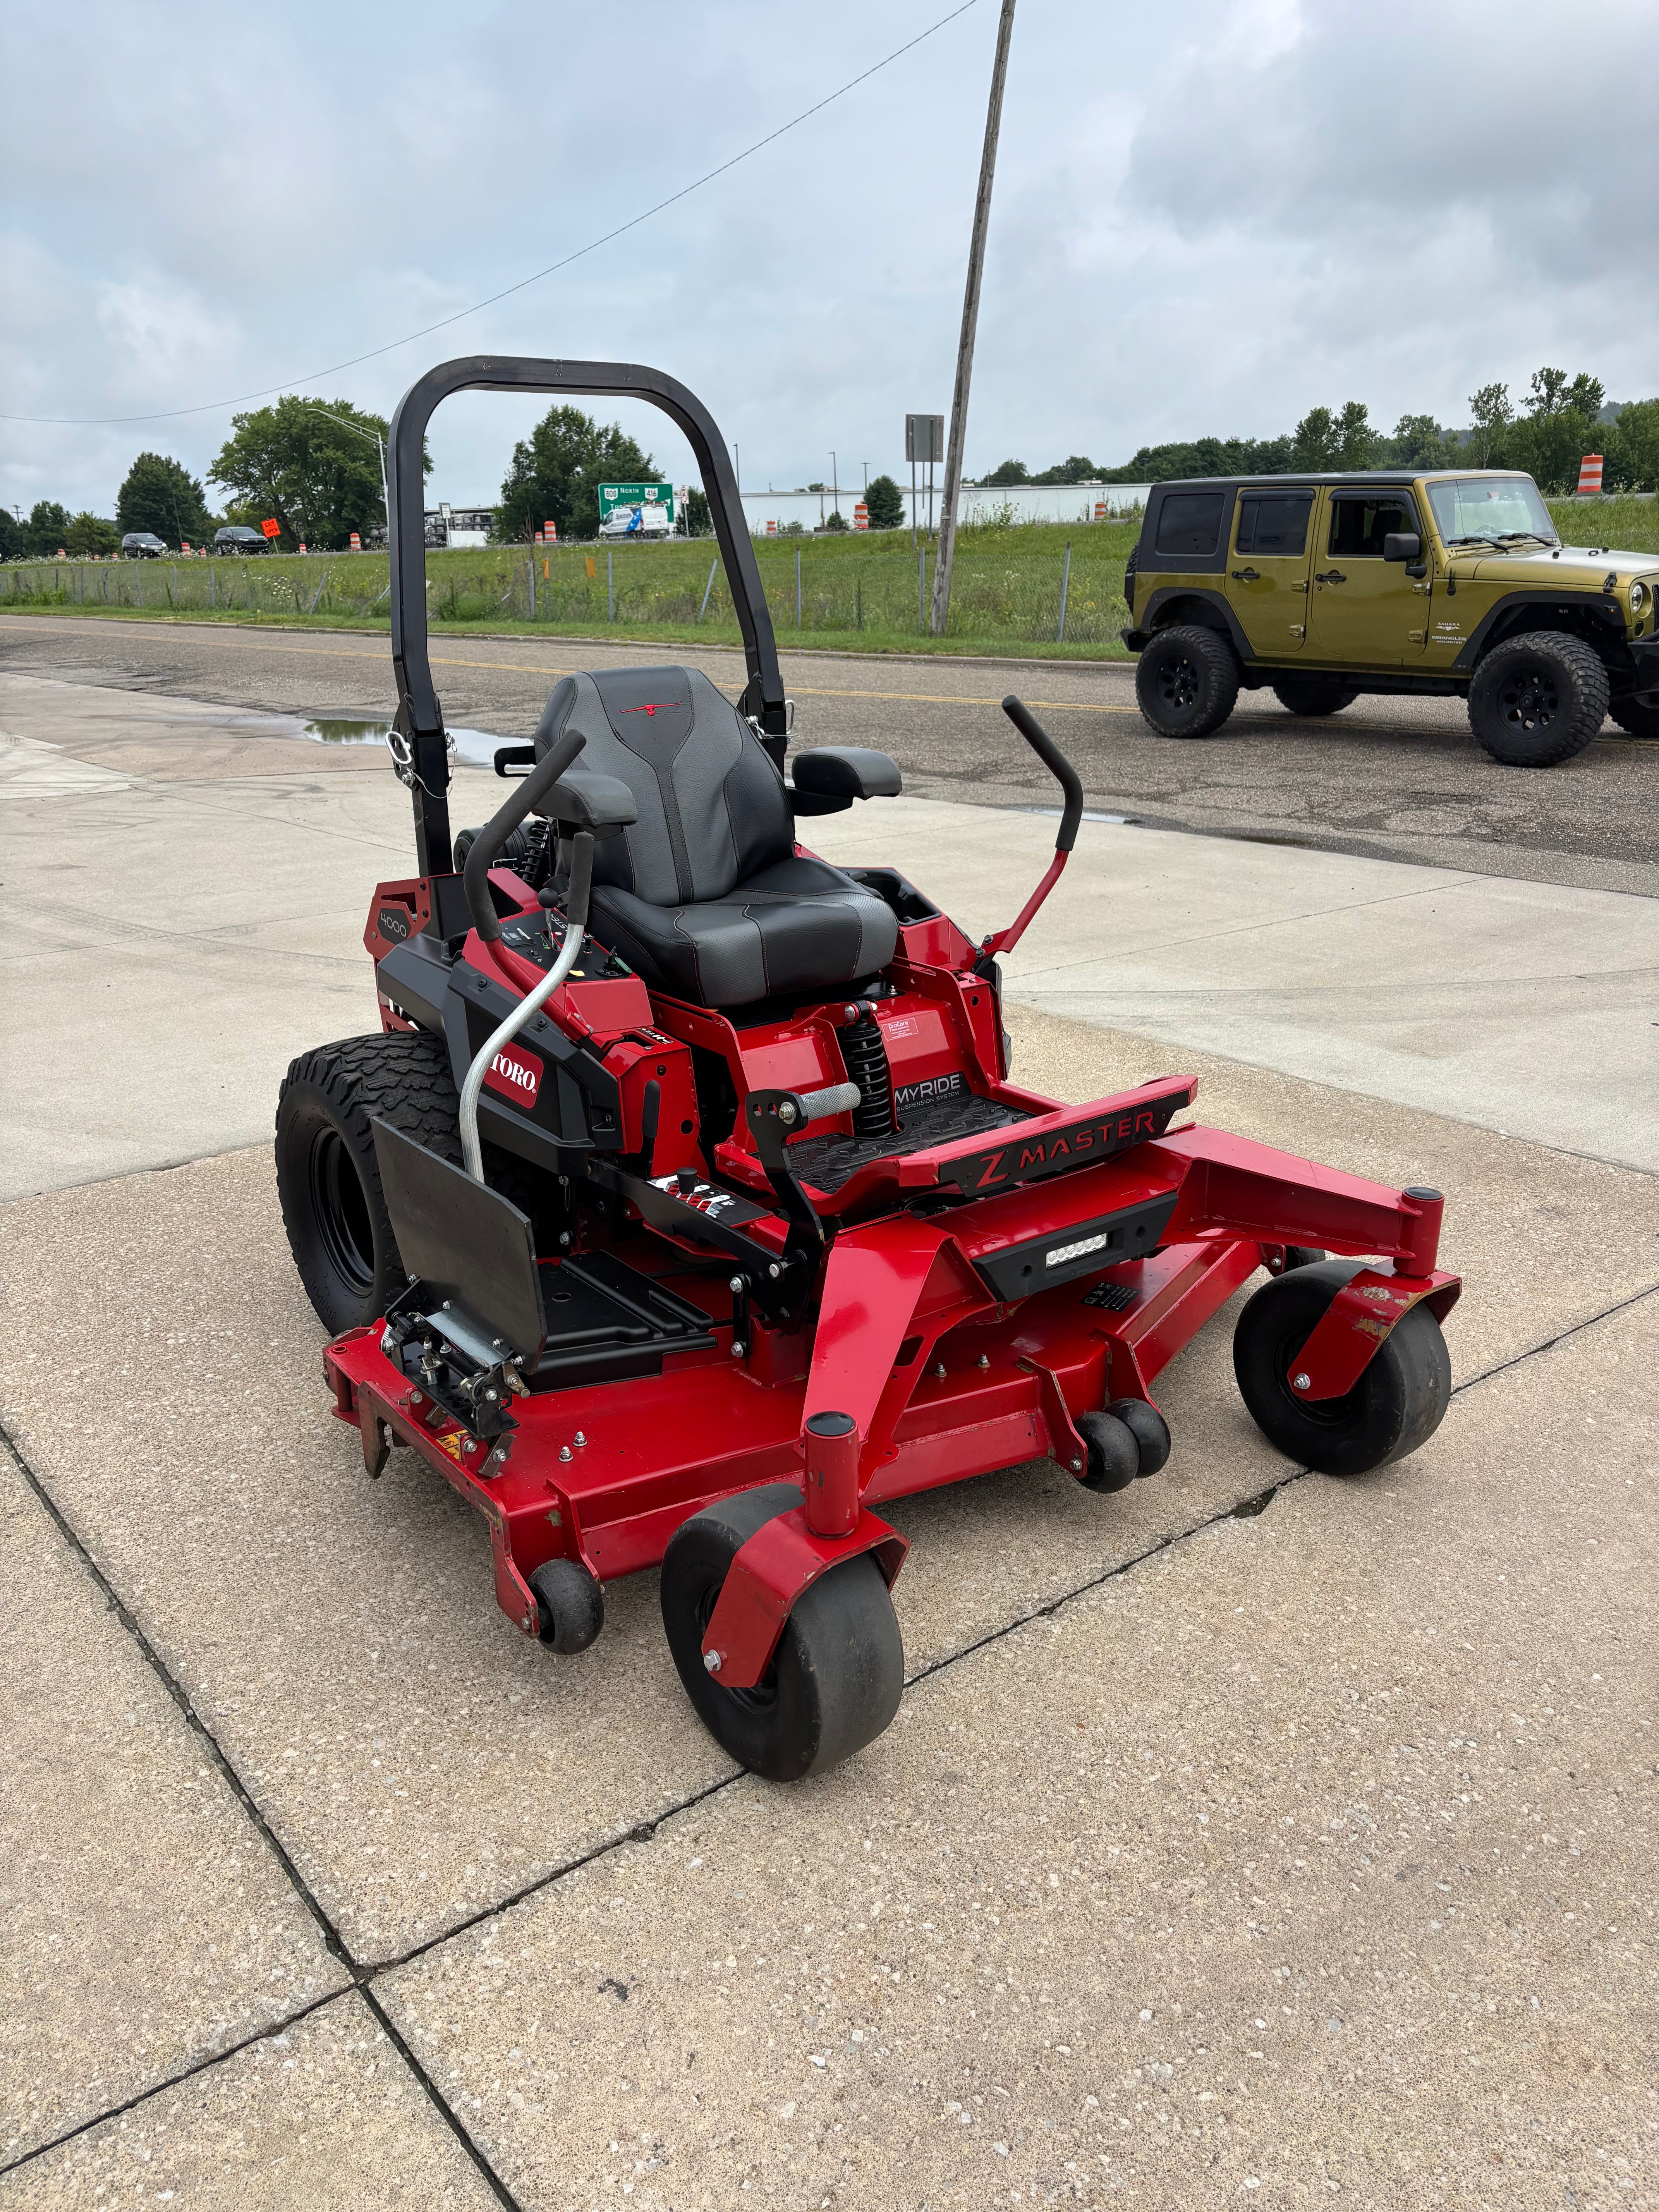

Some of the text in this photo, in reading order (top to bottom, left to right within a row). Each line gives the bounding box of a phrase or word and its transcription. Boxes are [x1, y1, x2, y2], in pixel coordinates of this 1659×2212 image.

[380, 912, 406, 937] 4000
[490, 1053, 536, 1091] TORO
[896, 1091, 960, 1112] SUSPENSION SYSTEM
[976, 1111, 1157, 1188] Z MASTER
